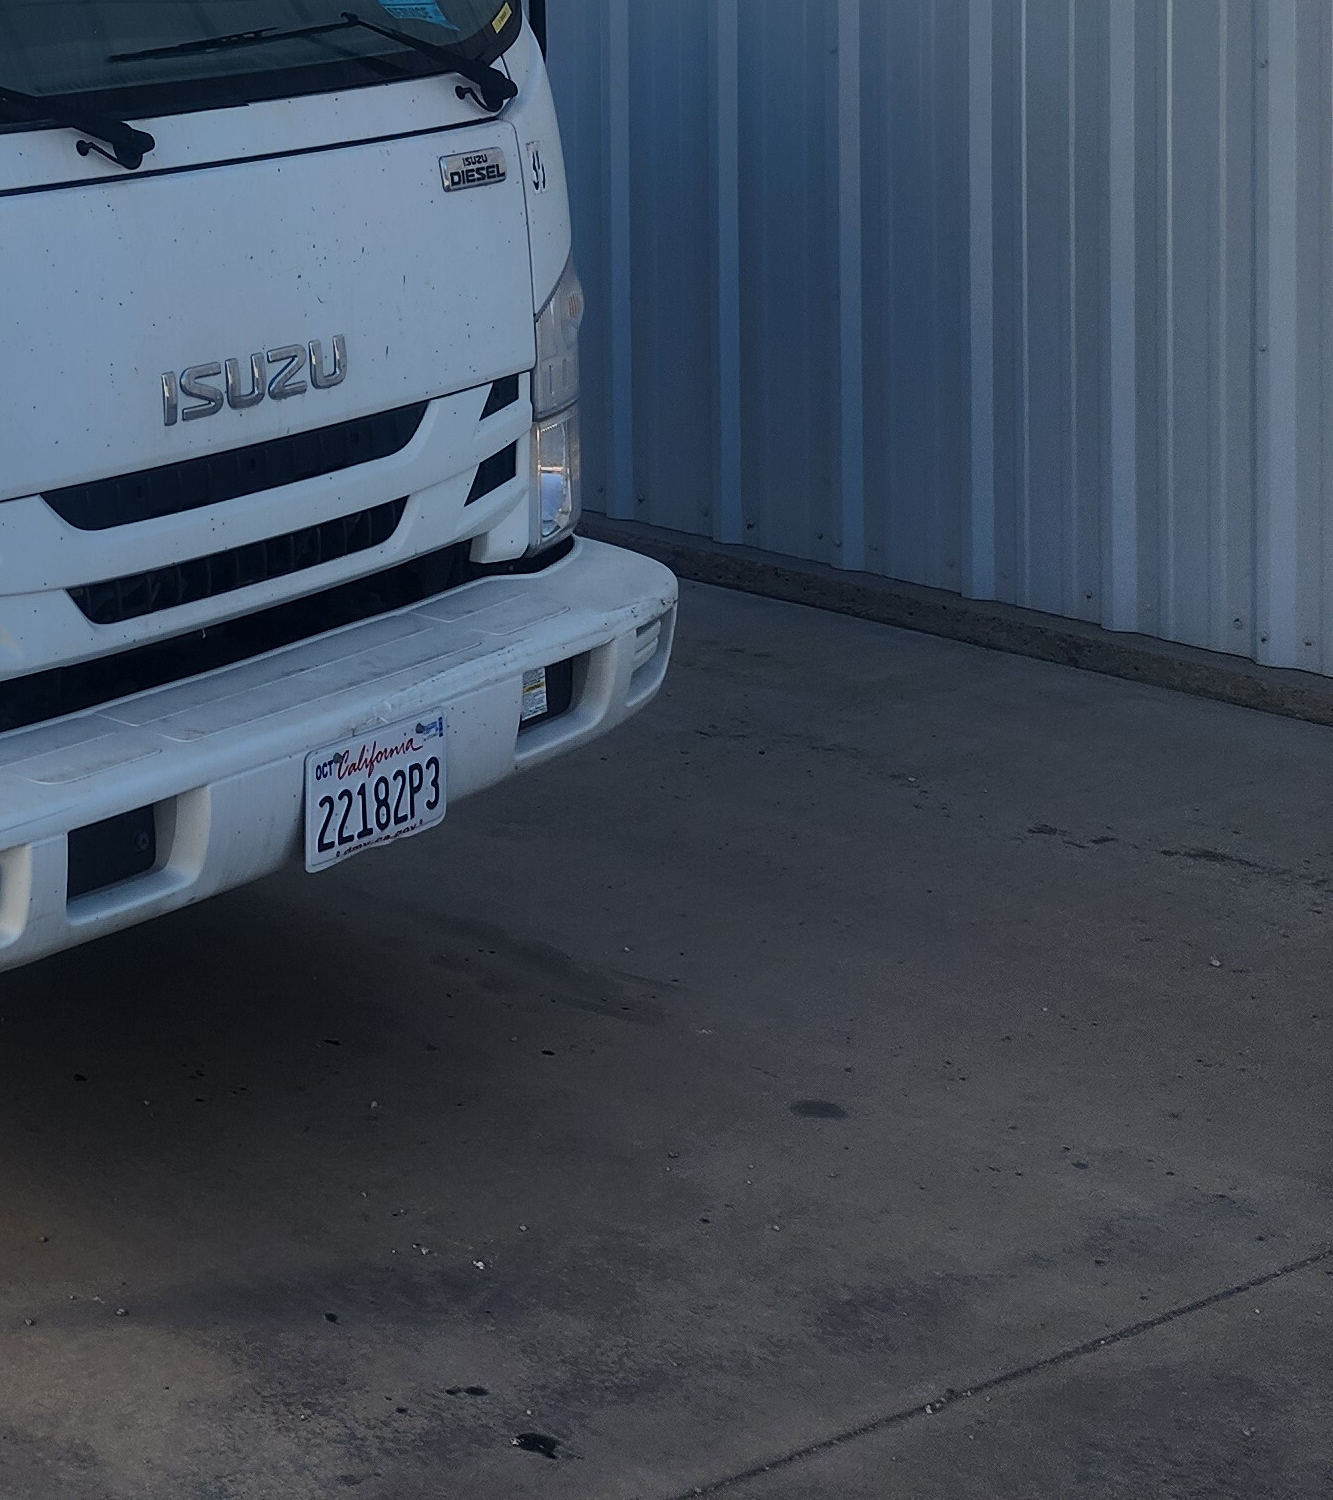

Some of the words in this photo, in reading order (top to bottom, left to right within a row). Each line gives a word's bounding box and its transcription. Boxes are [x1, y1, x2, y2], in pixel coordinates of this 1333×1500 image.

[449, 163, 506, 187] DIESEL
[462, 153, 488, 167] ISUZU
[160, 333, 348, 427] ISUZU
[315, 759, 334, 781] OCT
[336, 736, 424, 781] California
[317, 756, 440, 854] 22182P3
